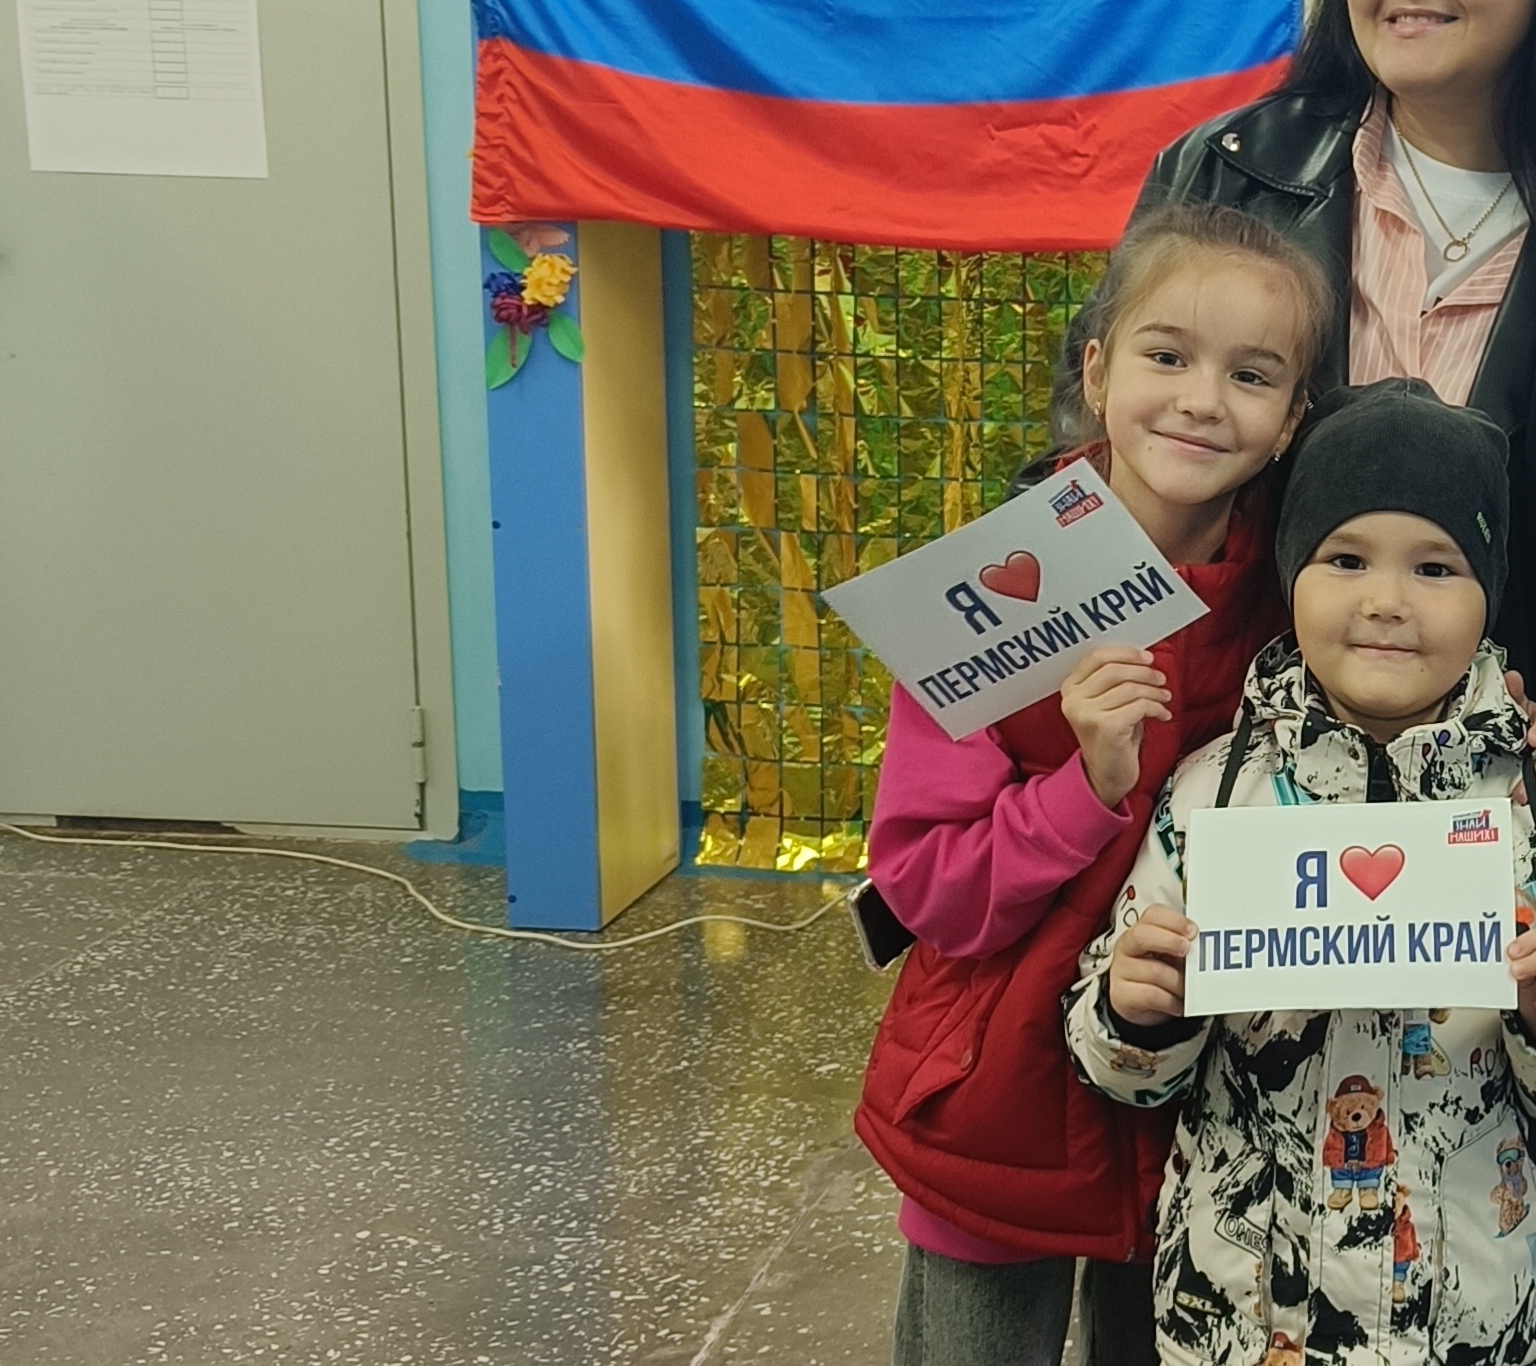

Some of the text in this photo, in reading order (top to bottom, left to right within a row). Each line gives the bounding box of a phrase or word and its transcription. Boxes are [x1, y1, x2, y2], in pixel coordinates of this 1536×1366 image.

[917, 561, 1175, 709] ПЕРМСКИЙ КРАЙ
[945, 581, 1003, 635] Я
[1295, 850, 1328, 909] Я
[1199, 911, 1502, 972] ПЕРМСКИЙ КРАЙ
